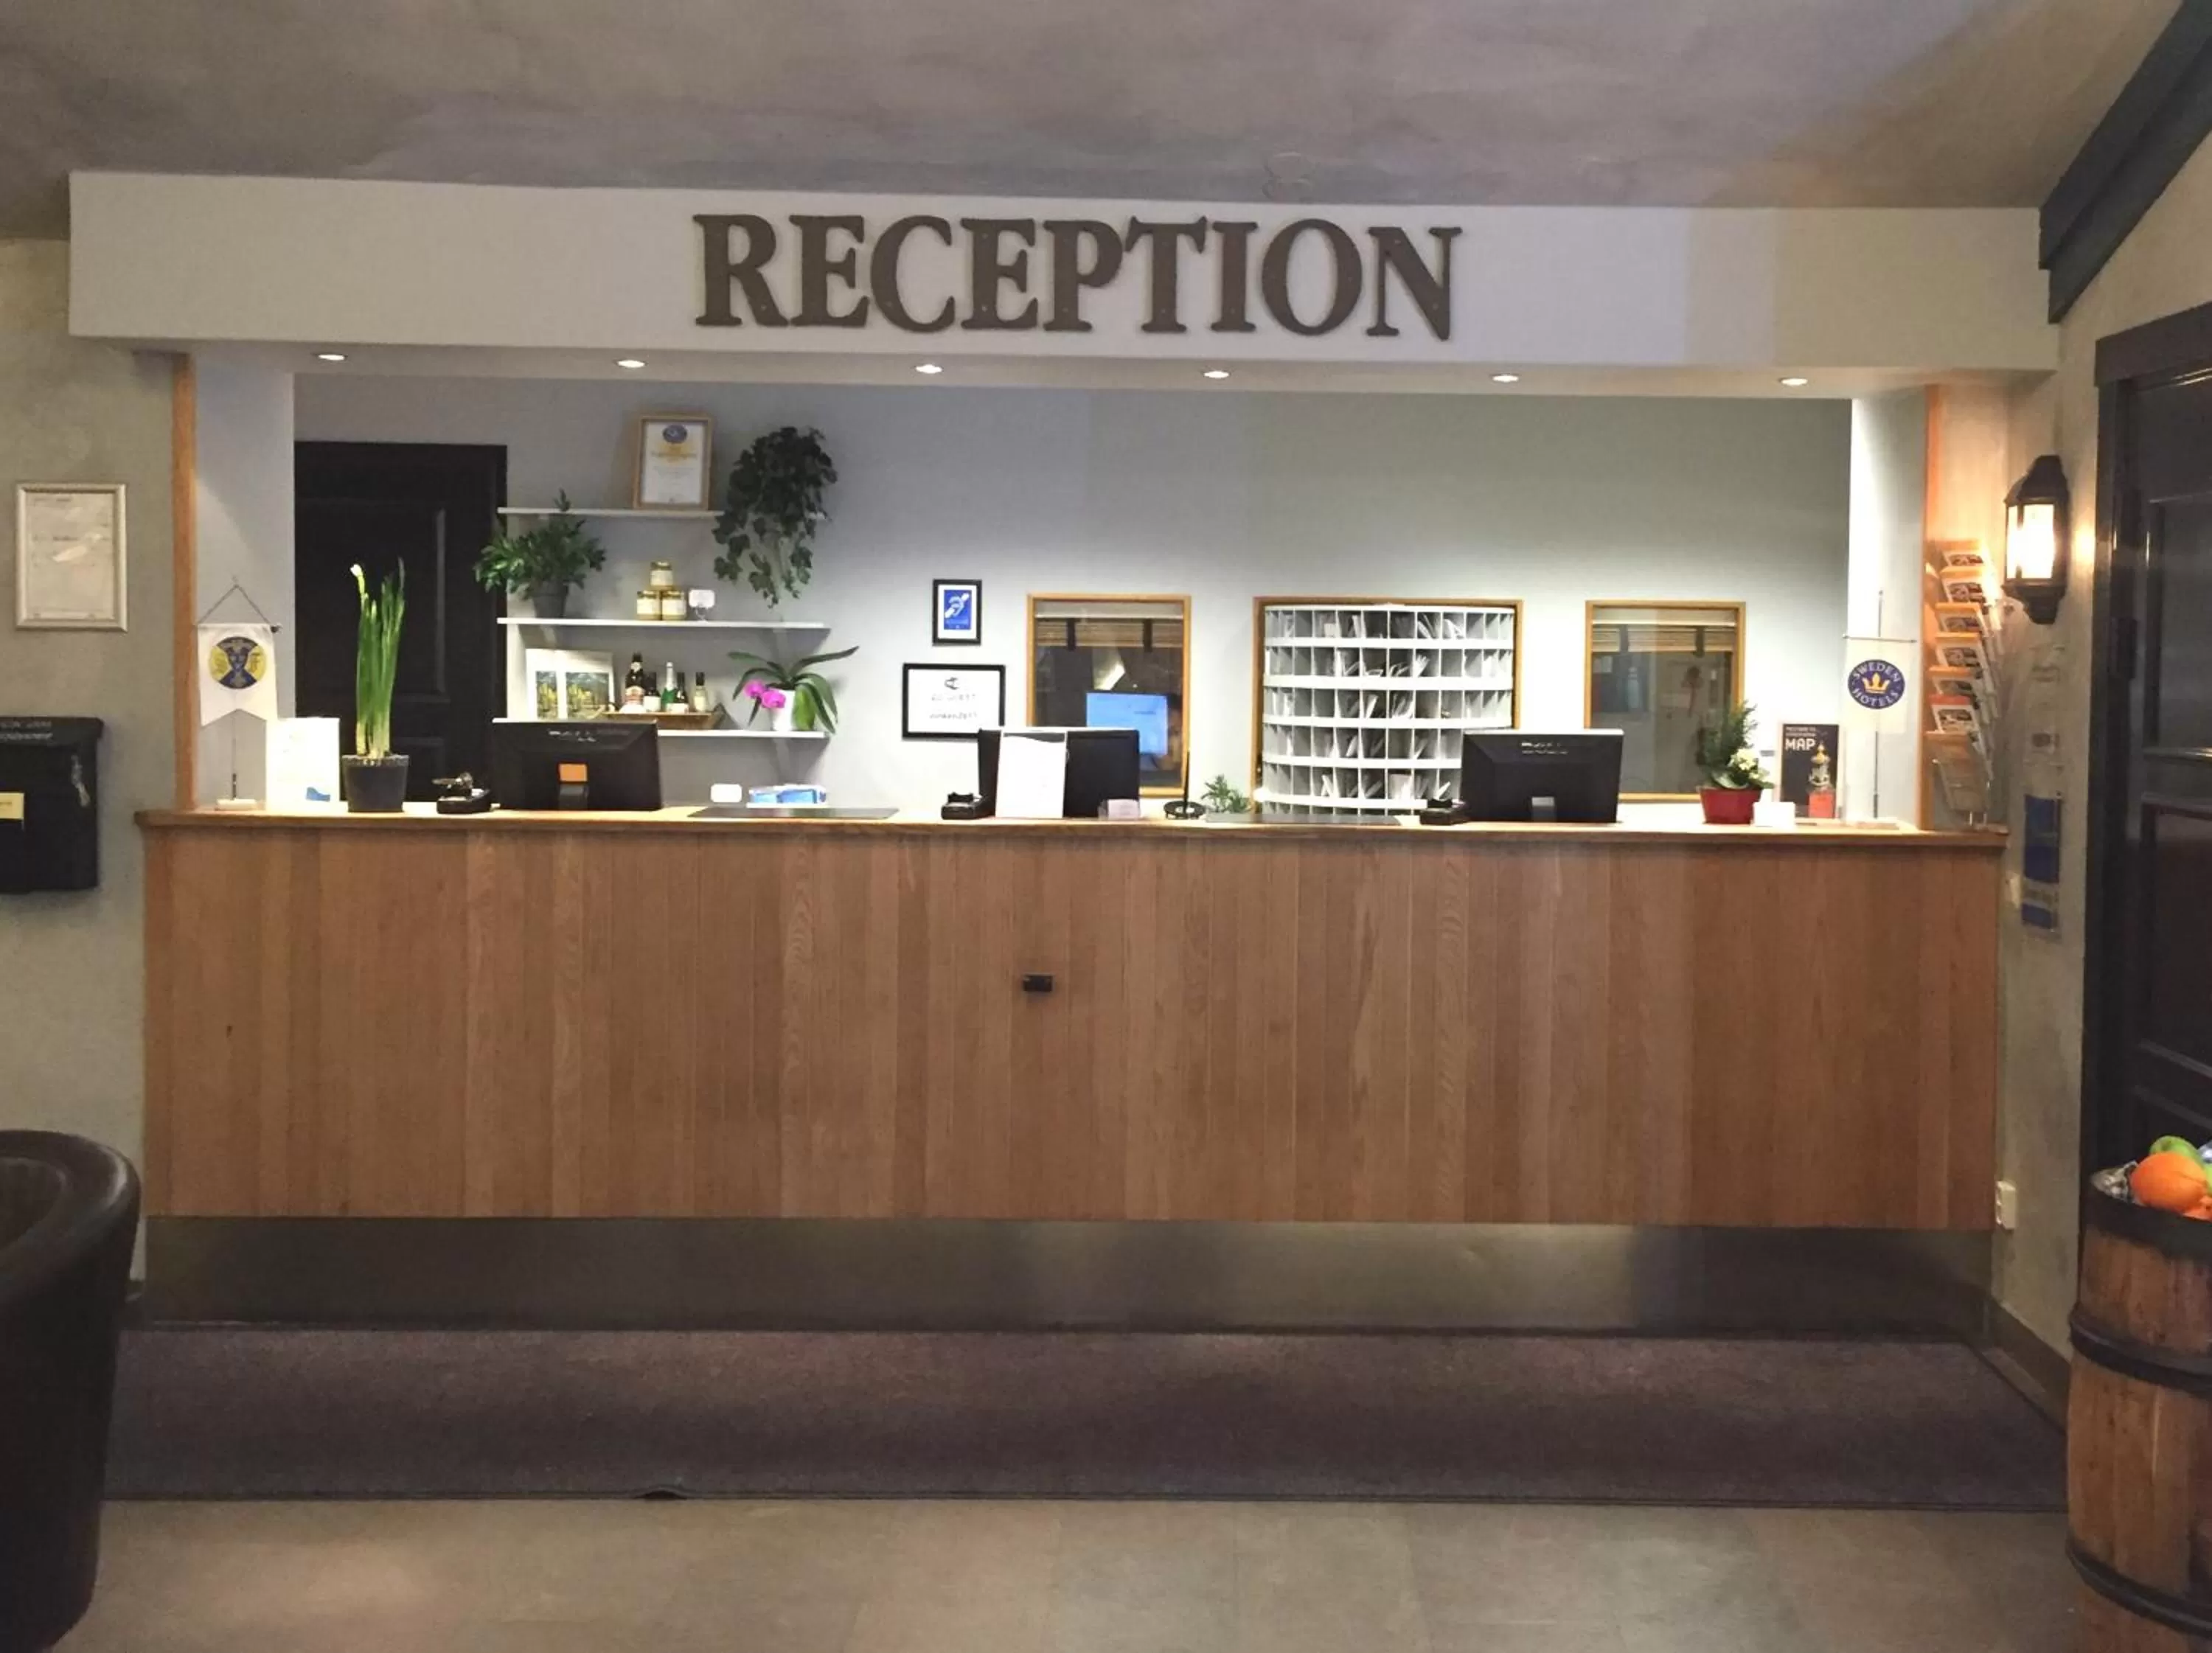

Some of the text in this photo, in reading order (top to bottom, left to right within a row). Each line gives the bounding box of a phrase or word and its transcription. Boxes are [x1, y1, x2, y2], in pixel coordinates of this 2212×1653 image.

[693, 215, 1461, 340] RECEPTION
[1851, 662, 1900, 681] SWEDEN
[1851, 689, 1899, 706] HOTELS
[1785, 738, 1815, 751] MAP
